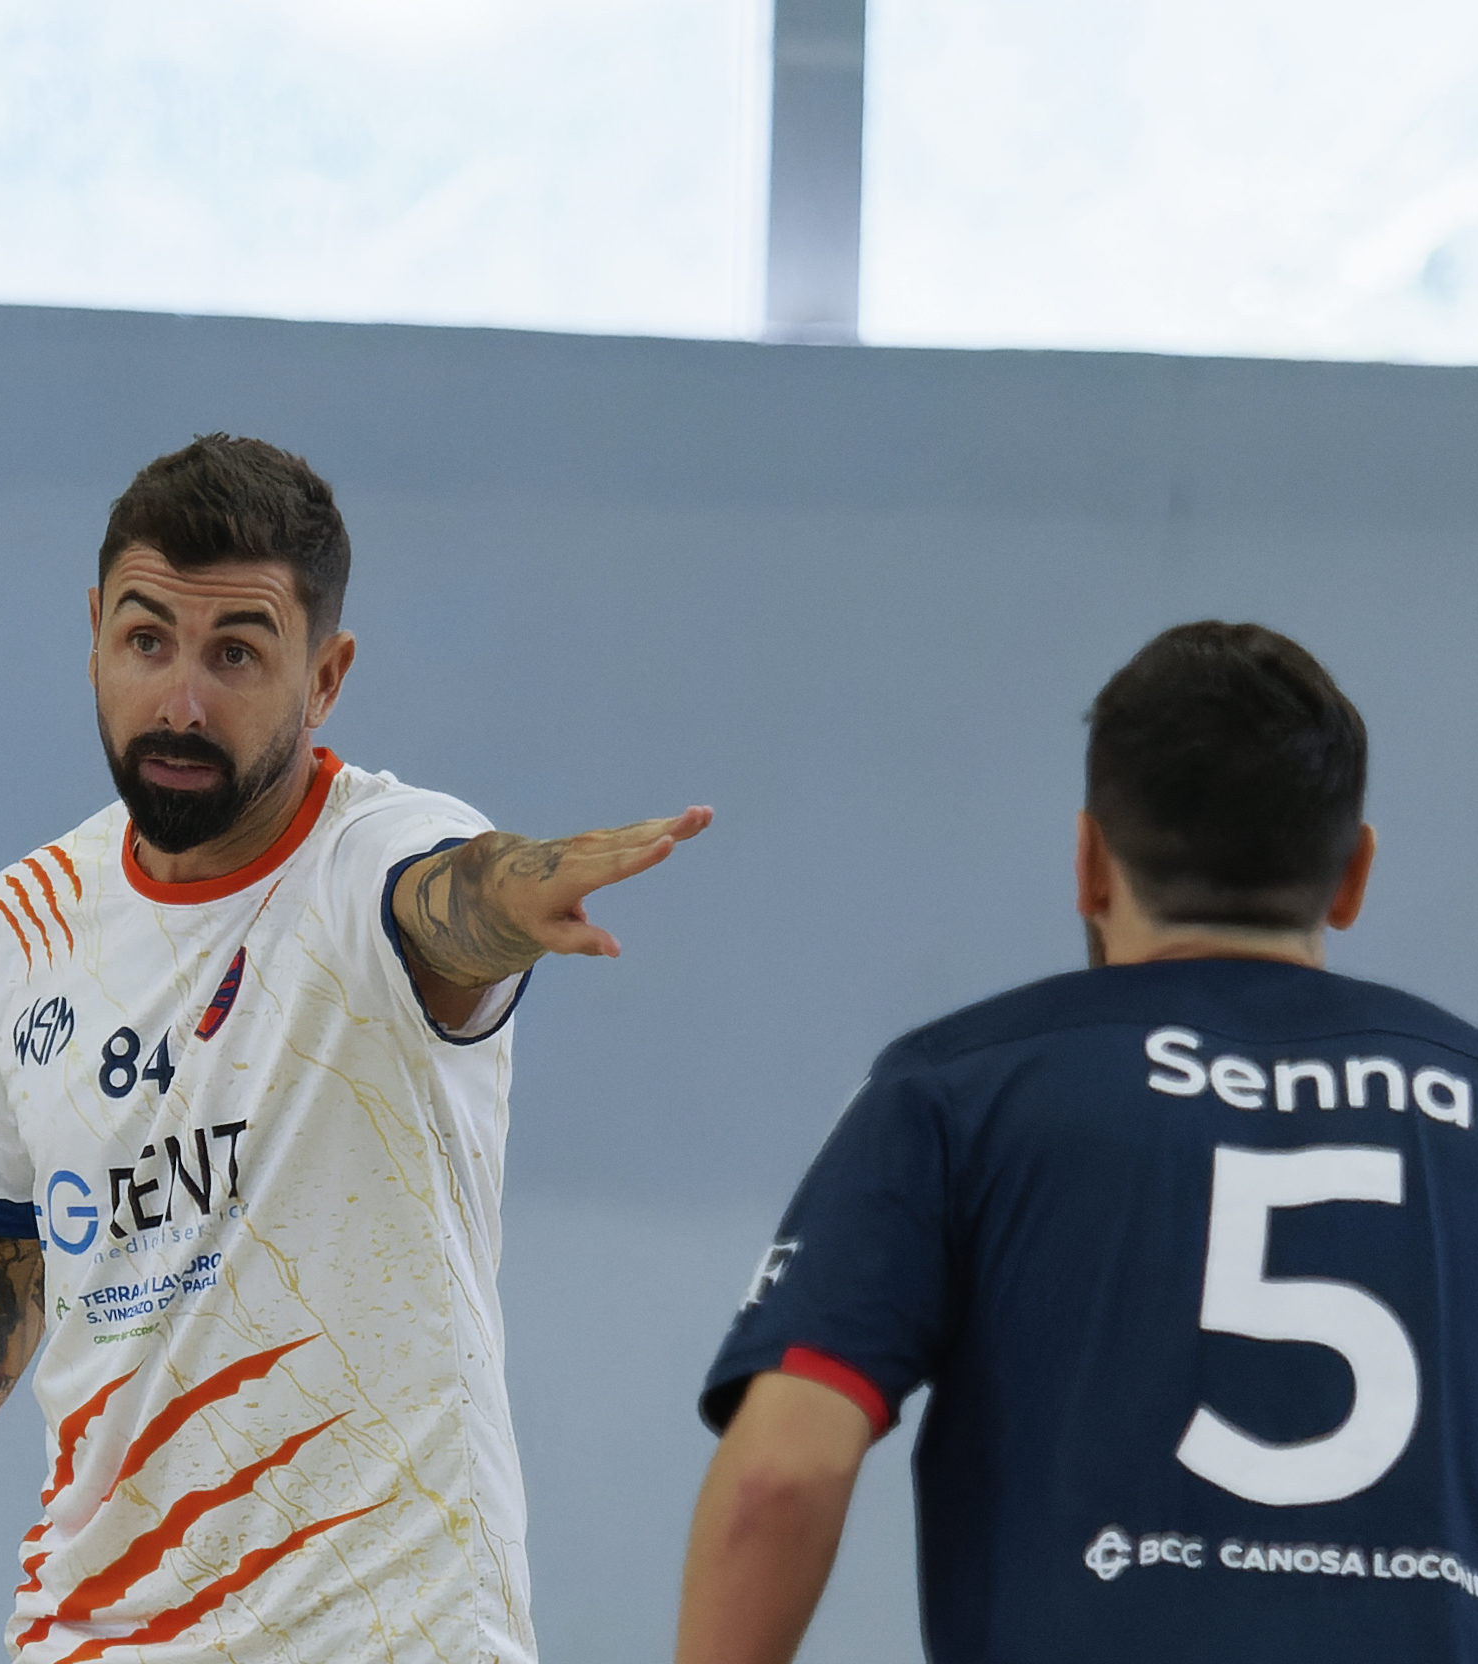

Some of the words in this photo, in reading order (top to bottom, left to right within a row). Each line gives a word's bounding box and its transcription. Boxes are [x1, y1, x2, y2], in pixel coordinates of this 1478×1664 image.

[99, 1026, 175, 1098] 84
[1145, 1026, 1473, 1129] Senna
[1176, 1147, 1421, 1507] 5
[1139, 1534, 1203, 1568] BCC
[1220, 1541, 1366, 1577] CANOSA
